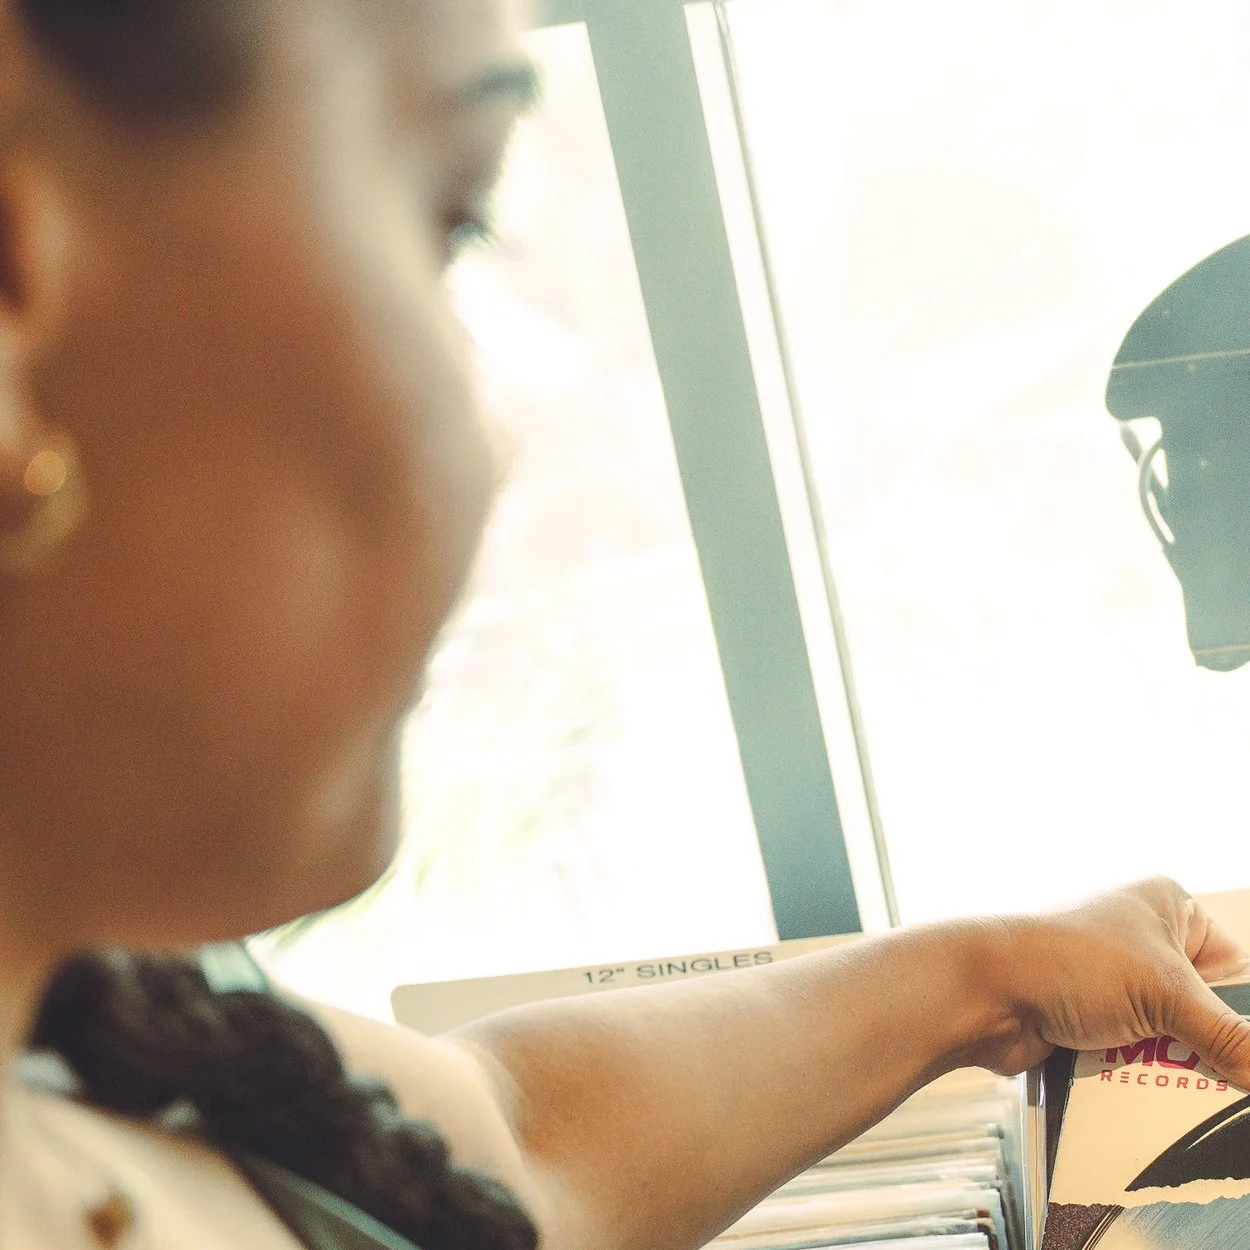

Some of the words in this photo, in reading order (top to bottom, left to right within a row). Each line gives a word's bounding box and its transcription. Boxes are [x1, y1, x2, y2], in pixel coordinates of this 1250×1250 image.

[584, 967, 626, 985] 12"
[636, 951, 774, 980] SINGLES
[1104, 1034, 1198, 1069] MC
[1101, 1069, 1229, 1092] RECORDS
